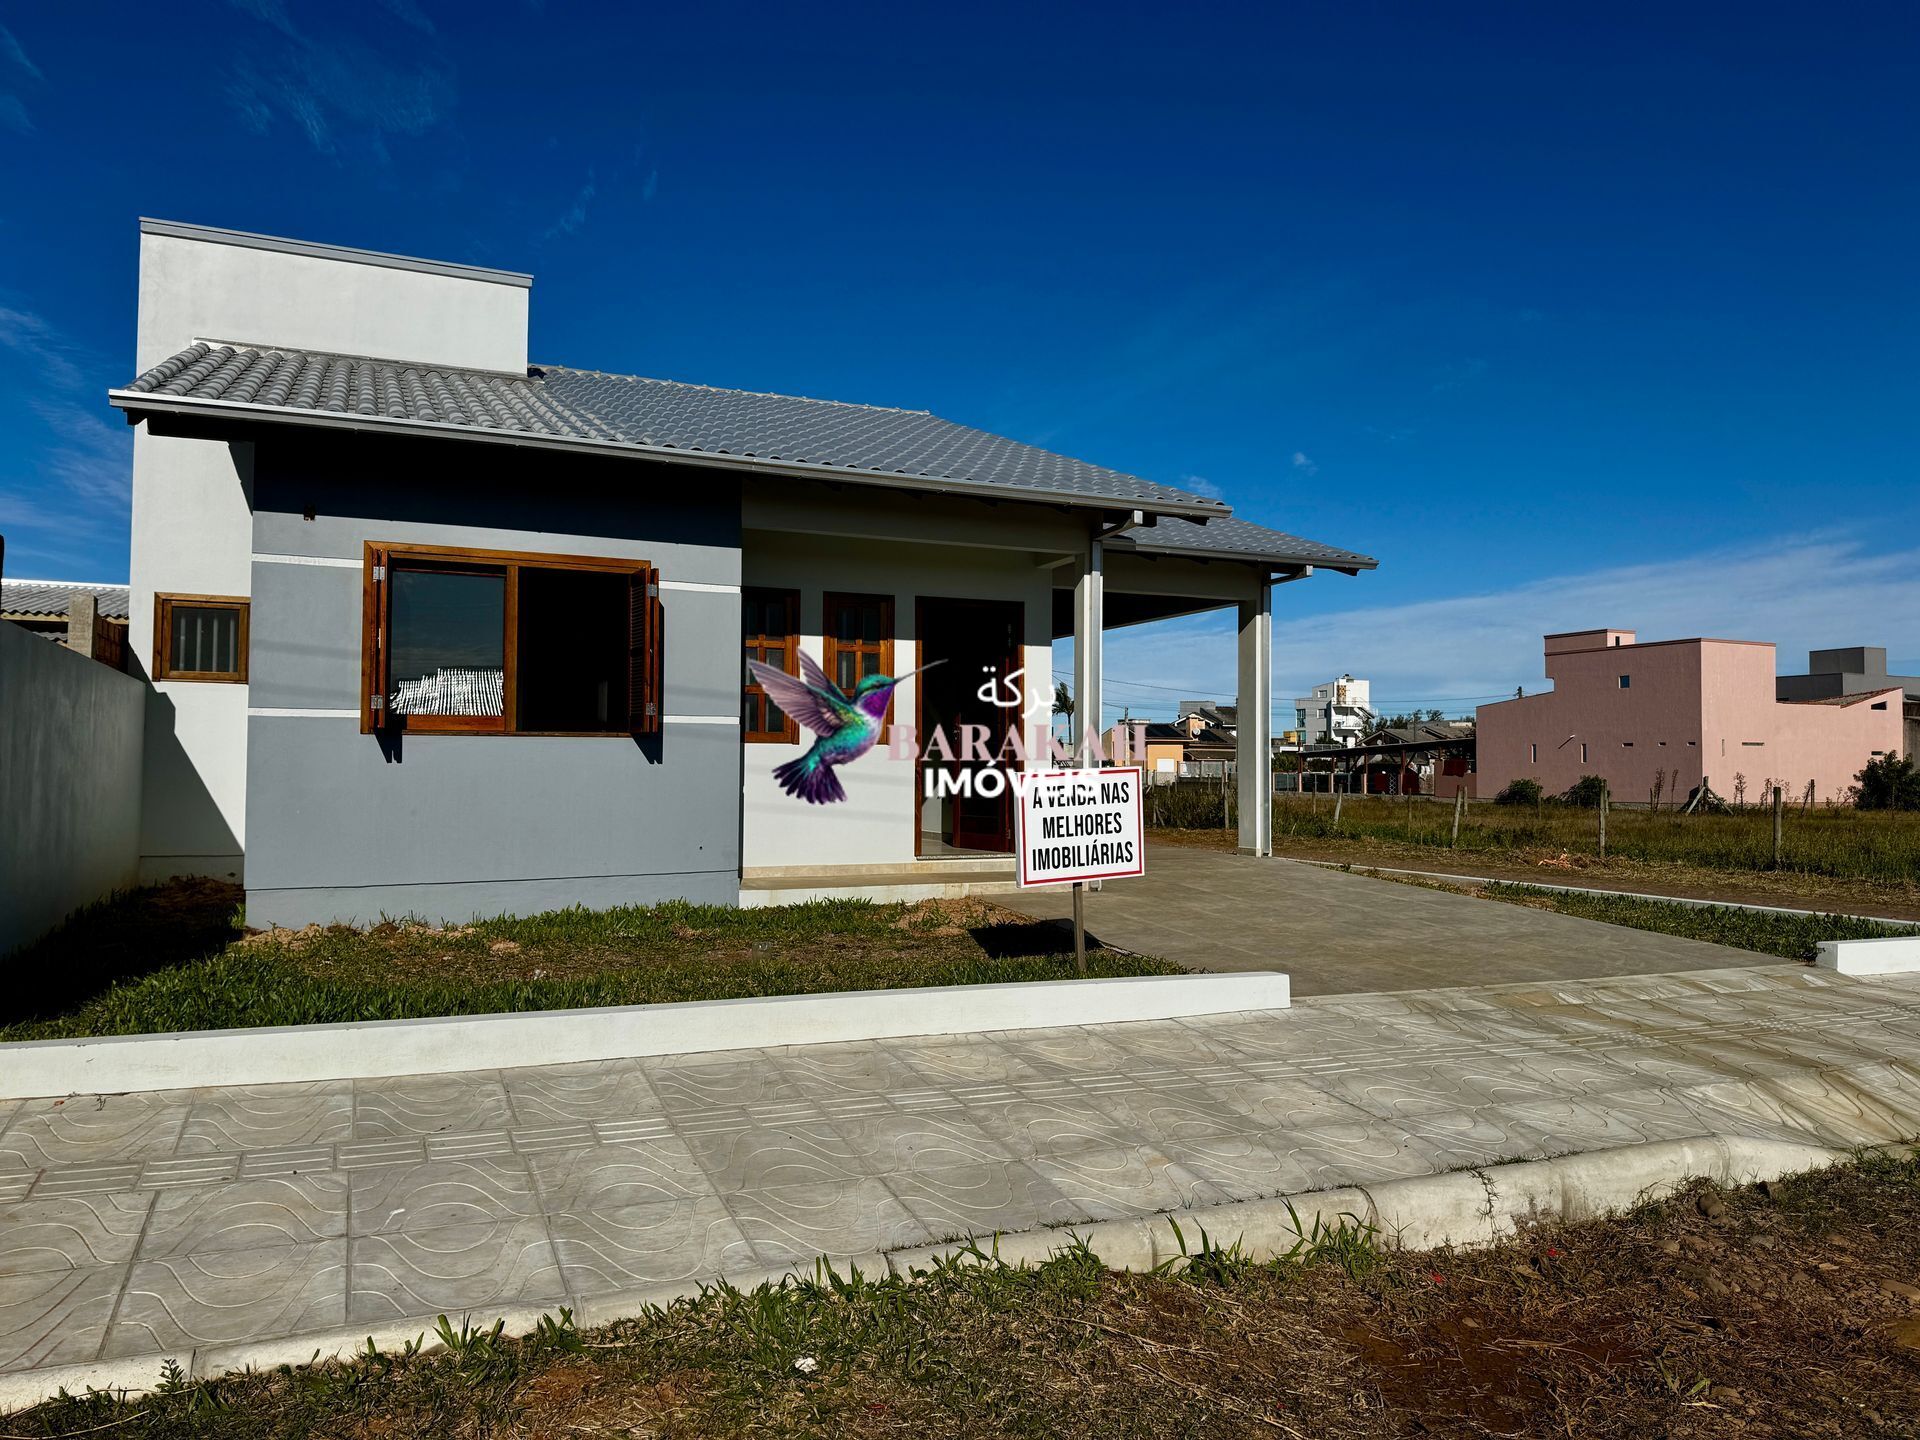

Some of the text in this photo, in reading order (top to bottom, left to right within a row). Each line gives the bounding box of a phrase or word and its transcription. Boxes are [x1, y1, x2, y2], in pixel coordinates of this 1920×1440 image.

[1032, 781, 1130, 809] A VENDA NAS
[1042, 812, 1122, 839] MELHORES
[1032, 839, 1133, 871] IMOBILIÁRIAS
